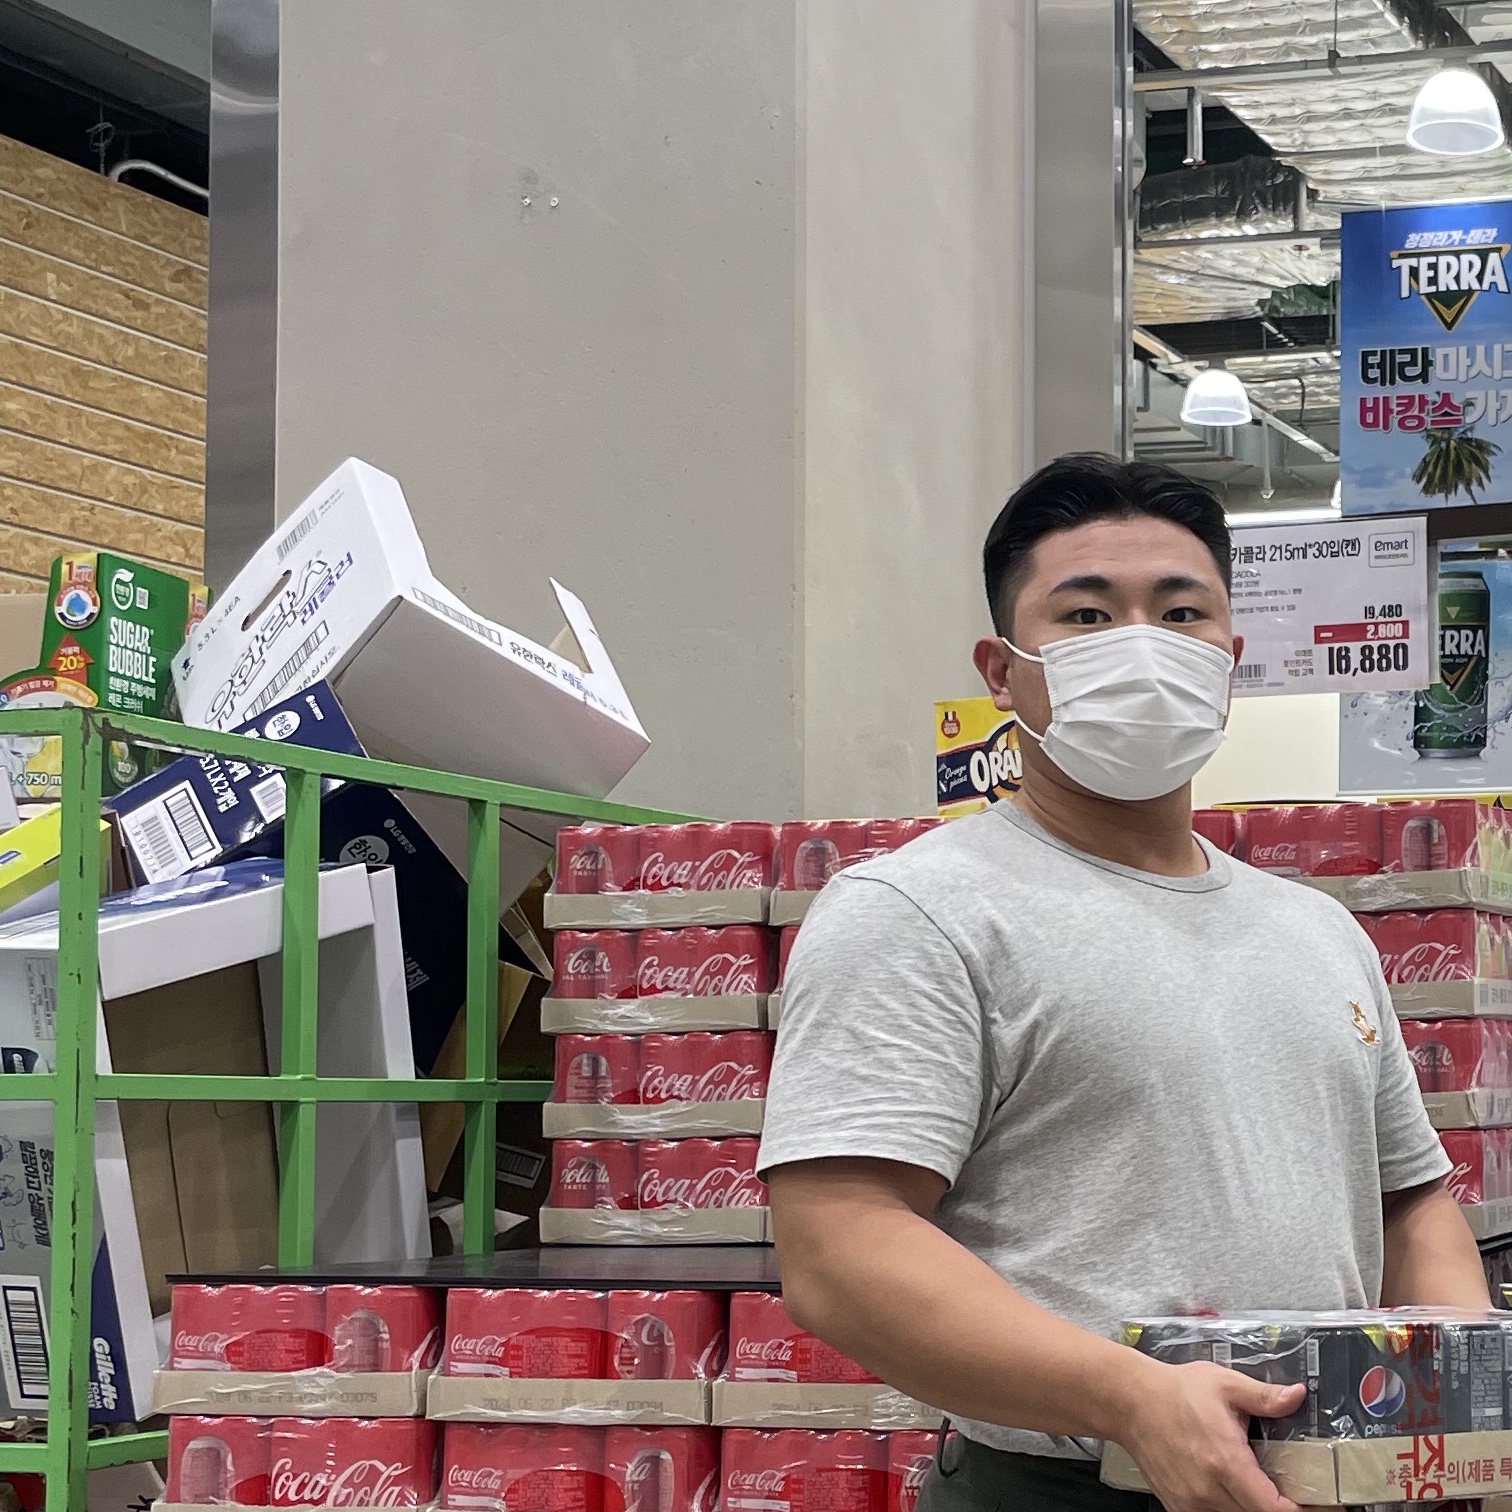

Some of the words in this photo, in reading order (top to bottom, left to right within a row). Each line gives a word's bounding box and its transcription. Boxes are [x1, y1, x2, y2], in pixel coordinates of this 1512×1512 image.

[1391, 252, 1509, 299] TERRA
[1359, 346, 1434, 387] 테라
[1358, 392, 1463, 434] 바캉스
[1374, 538, 1409, 552] emart
[1364, 604, 1403, 620] 19,480
[109, 616, 151, 655] SUGAR
[204, 558, 329, 731] 유한락스
[1366, 623, 1403, 640] 2,600
[109, 645, 157, 683] BUBBLE
[510, 641, 558, 677] 유한락스
[1328, 642, 1409, 677] 16,880
[27, 773, 47, 785] 750
[640, 849, 761, 891] Coca-Cola
[1251, 843, 1298, 861] Coca-Cola
[637, 954, 758, 998] Coca-Cola
[641, 1061, 760, 1103] Coca-Cola
[638, 1166, 757, 1209] Coca-Cola
[174, 1330, 226, 1354] Coca-Cola
[451, 1333, 504, 1357] Coca-Cola
[736, 1337, 793, 1363] Coca-Cola
[93, 1337, 118, 1410] Gillette
[272, 1458, 414, 1507] Coca-Cola
[448, 1465, 501, 1490] Coca-Cola
[727, 1469, 785, 1493] Coca-Cola
